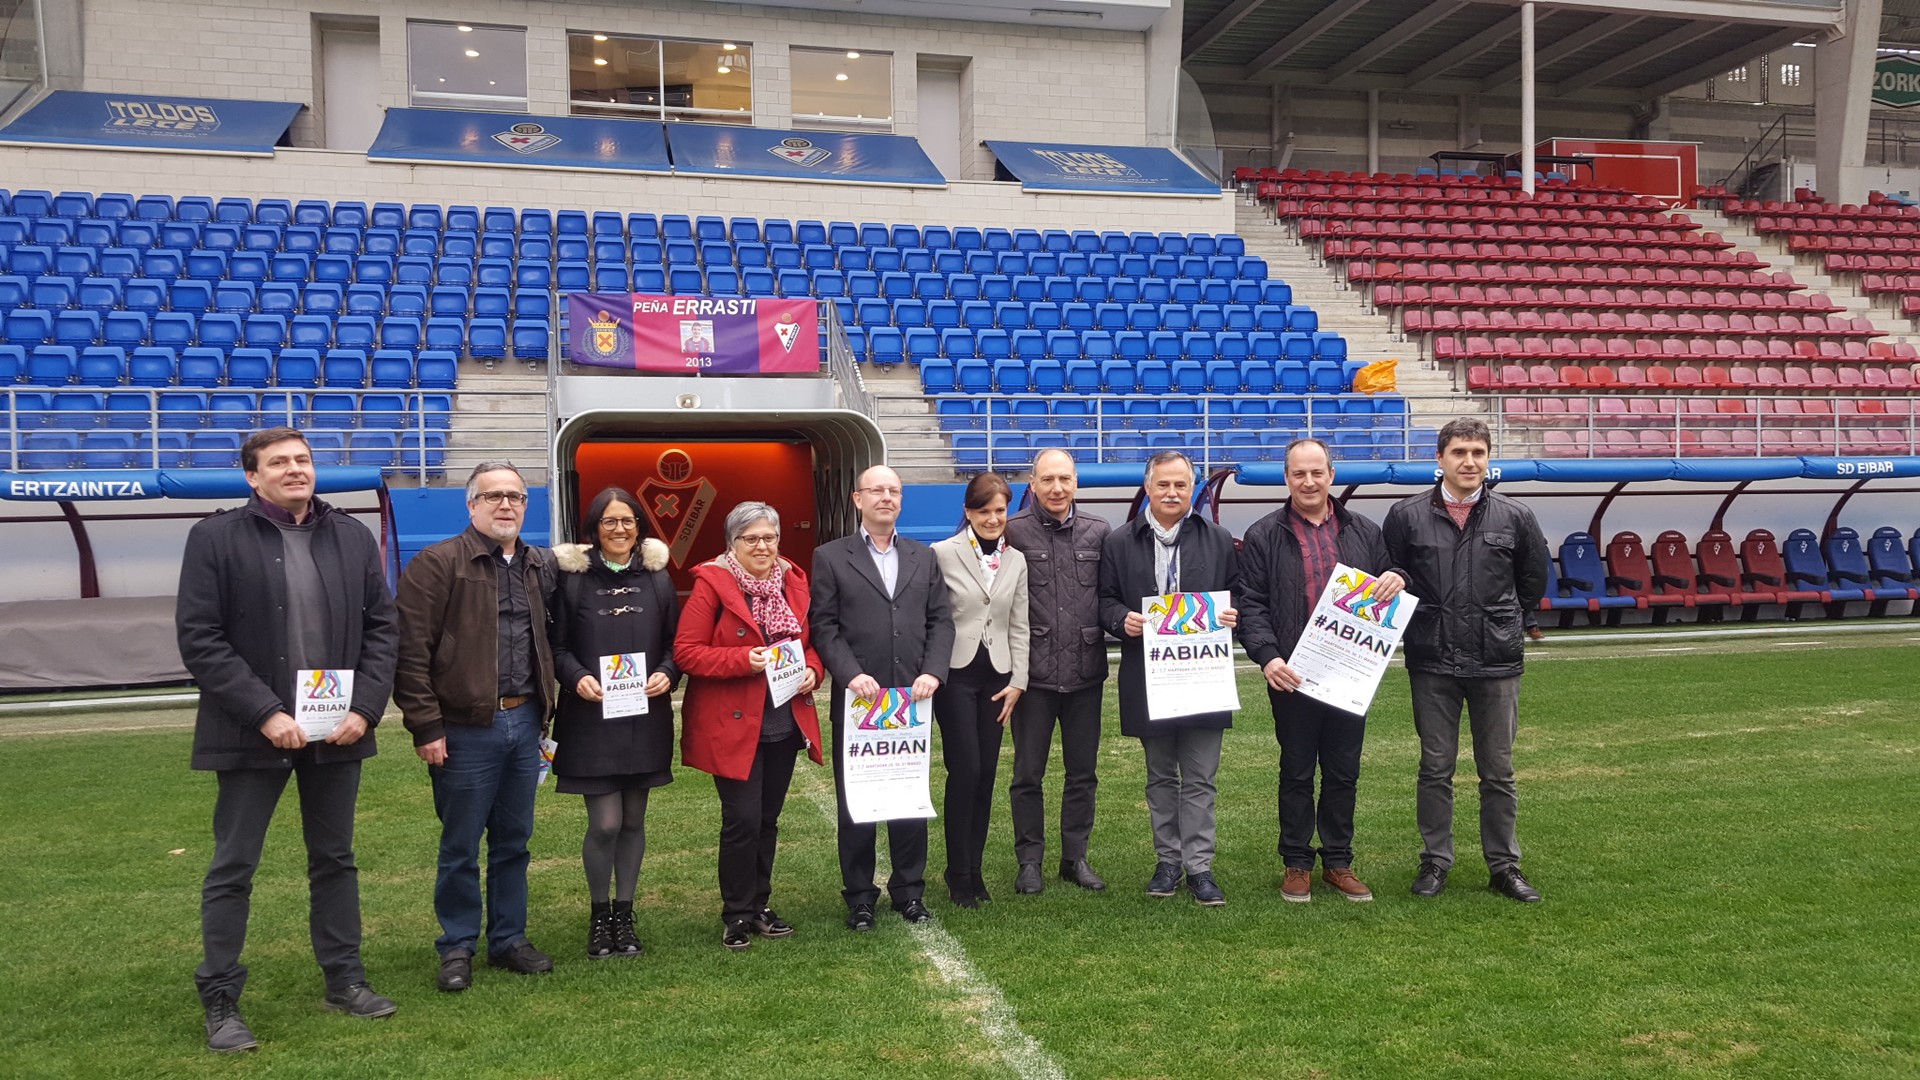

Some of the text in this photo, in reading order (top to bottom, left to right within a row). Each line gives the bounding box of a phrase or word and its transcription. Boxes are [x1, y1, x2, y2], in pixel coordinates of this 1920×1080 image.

[110, 101, 216, 123] TOLDOS
[633, 299, 757, 315] PEÑA ERRASTI
[685, 357, 712, 368] 2013
[1837, 461, 1894, 475] SD EIBAR
[10, 480, 146, 497] ERTZAINTZA
[1314, 614, 1392, 658] #ABIAN
[1149, 643, 1229, 662] #ABIAN
[301, 703, 347, 713] #ABIAN
[849, 739, 926, 757] #ABIAN
